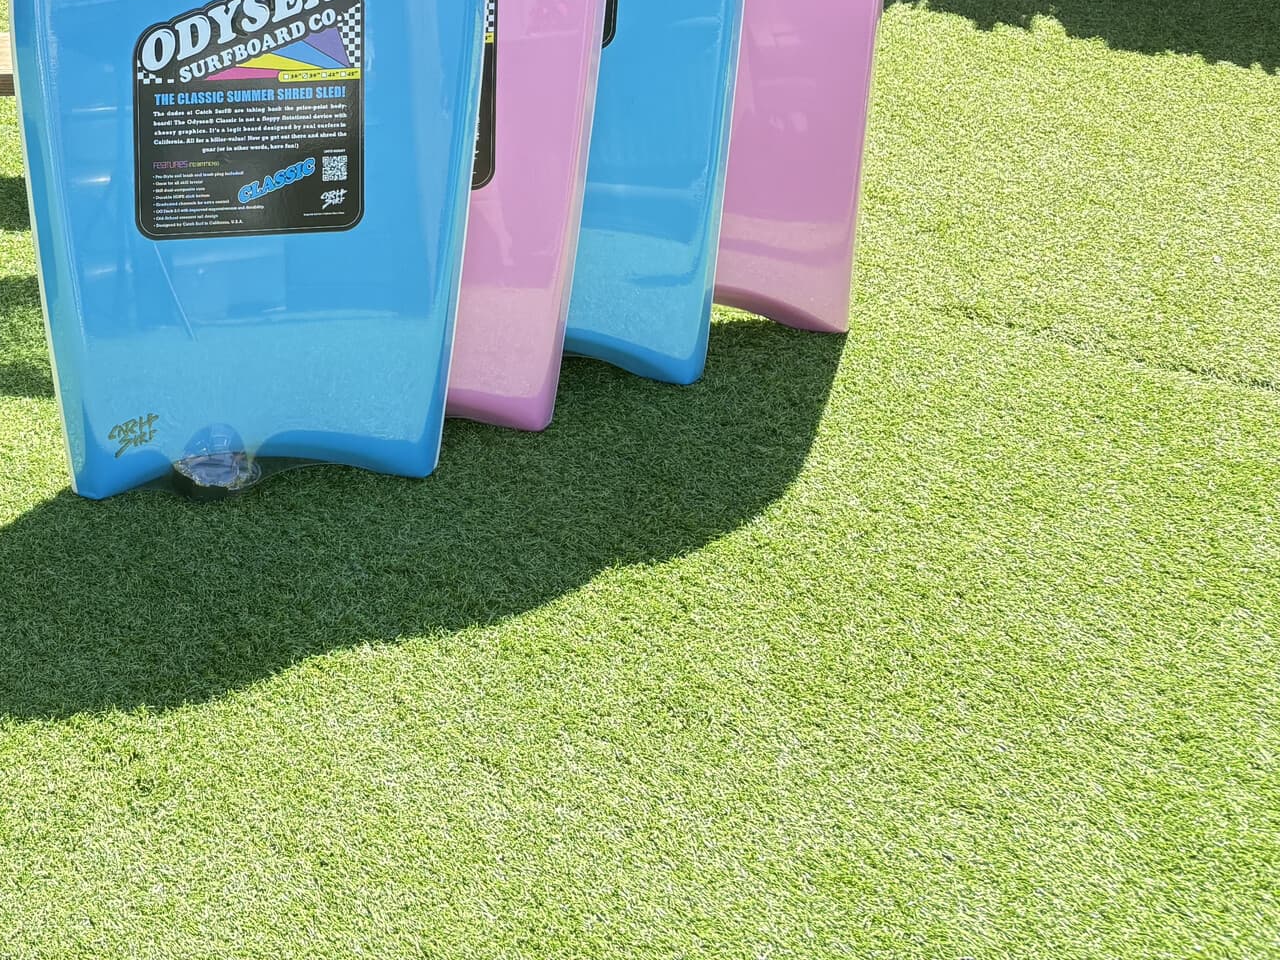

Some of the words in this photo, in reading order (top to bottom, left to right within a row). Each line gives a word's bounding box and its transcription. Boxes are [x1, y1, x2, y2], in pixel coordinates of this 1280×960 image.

[179, 20, 305, 83] SURFBOARD
[309, 9, 343, 30] CO.
[154, 93, 175, 106] THE
[178, 91, 224, 105] CLASSIC
[227, 89, 275, 103] SUMMER
[278, 87, 312, 101] SHRED
[315, 85, 346, 99] SLED!
[237, 157, 316, 203] CLASSIC
